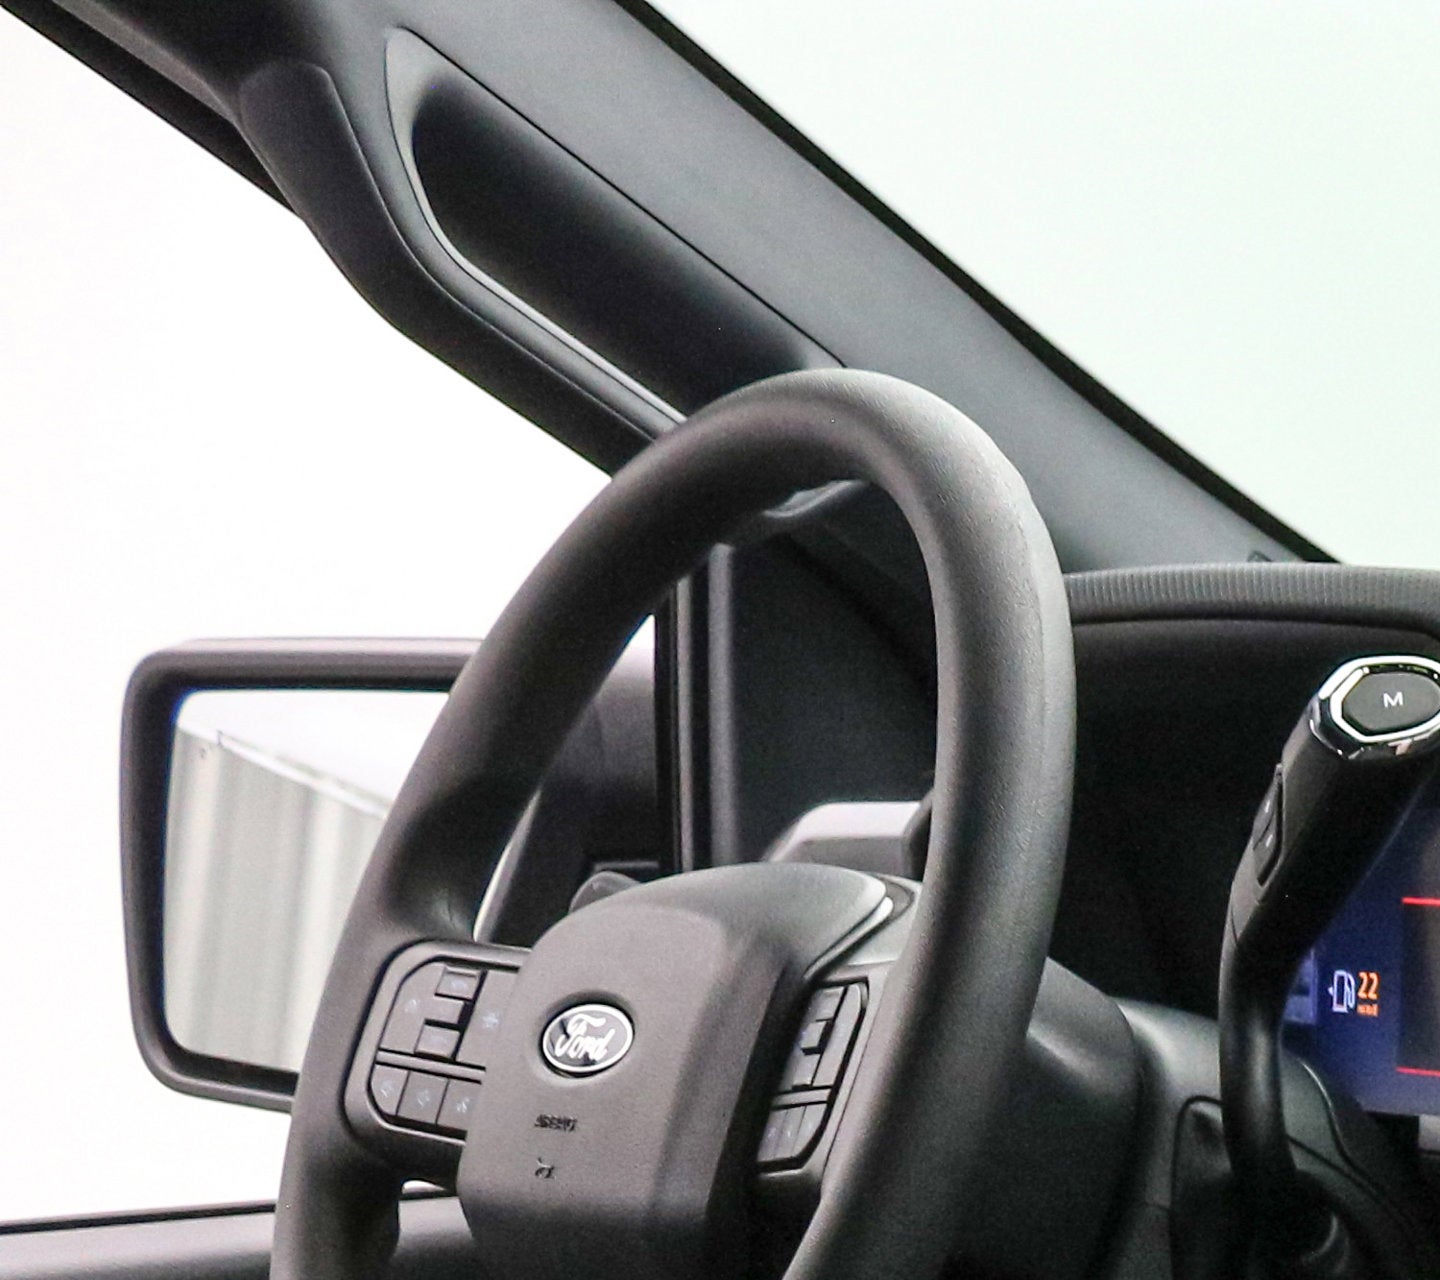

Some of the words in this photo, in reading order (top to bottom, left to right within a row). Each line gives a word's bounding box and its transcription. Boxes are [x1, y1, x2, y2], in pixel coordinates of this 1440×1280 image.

[1383, 691, 1404, 708] M
[1357, 971, 1379, 1000] 22
[555, 1013, 615, 1061] Ford
